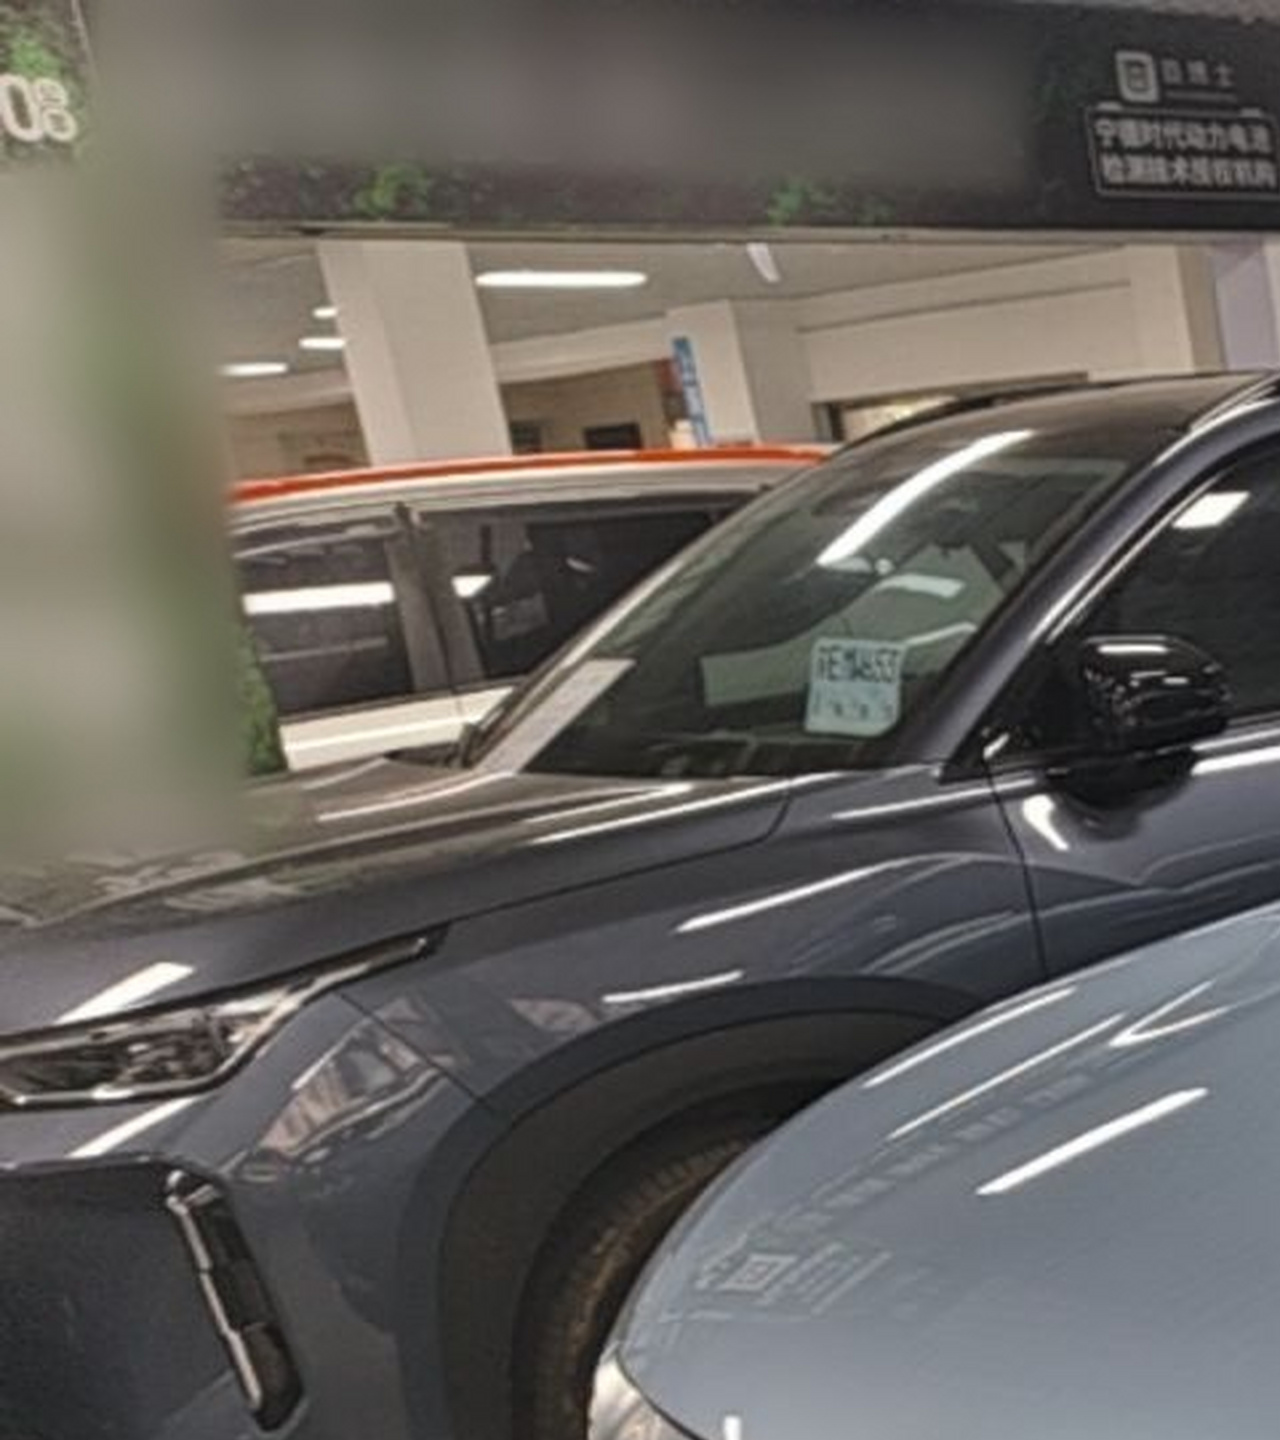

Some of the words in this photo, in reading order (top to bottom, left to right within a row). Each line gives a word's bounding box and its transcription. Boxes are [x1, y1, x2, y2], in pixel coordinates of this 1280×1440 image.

[1095, 118, 1272, 154] 宁德时代动力电池
[1100, 151, 1277, 189] 检测技术授权机构
